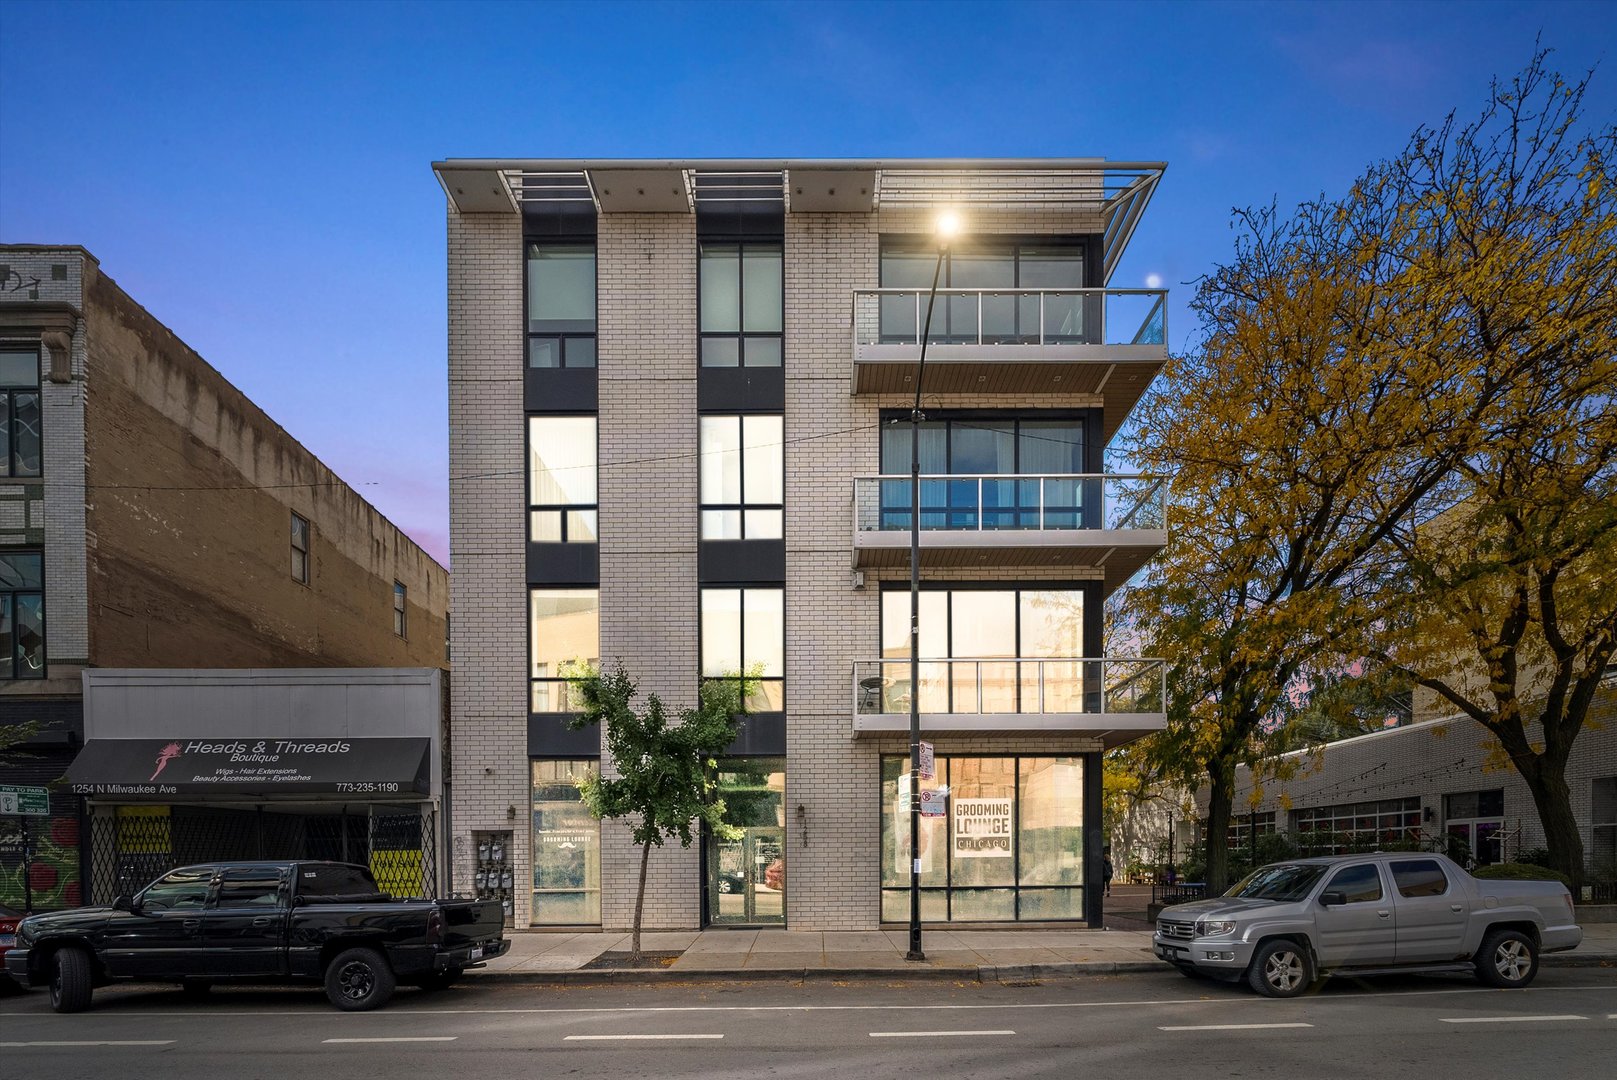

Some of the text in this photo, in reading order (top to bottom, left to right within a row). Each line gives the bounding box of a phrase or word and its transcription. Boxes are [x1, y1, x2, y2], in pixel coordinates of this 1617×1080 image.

[184, 740, 351, 754] Heads & Threads
[230, 753, 280, 764] Boutique
[215, 768, 234, 776] Wigs
[192, 775, 219, 783] Beauty
[272, 775, 312, 783] Eyelashes
[71, 784, 177, 794] 1254 N Milwaukee Ave
[336, 783, 399, 792] 773-235-1190
[956, 803, 1009, 816] GROOMING
[958, 840, 1007, 848] CHICAGO
